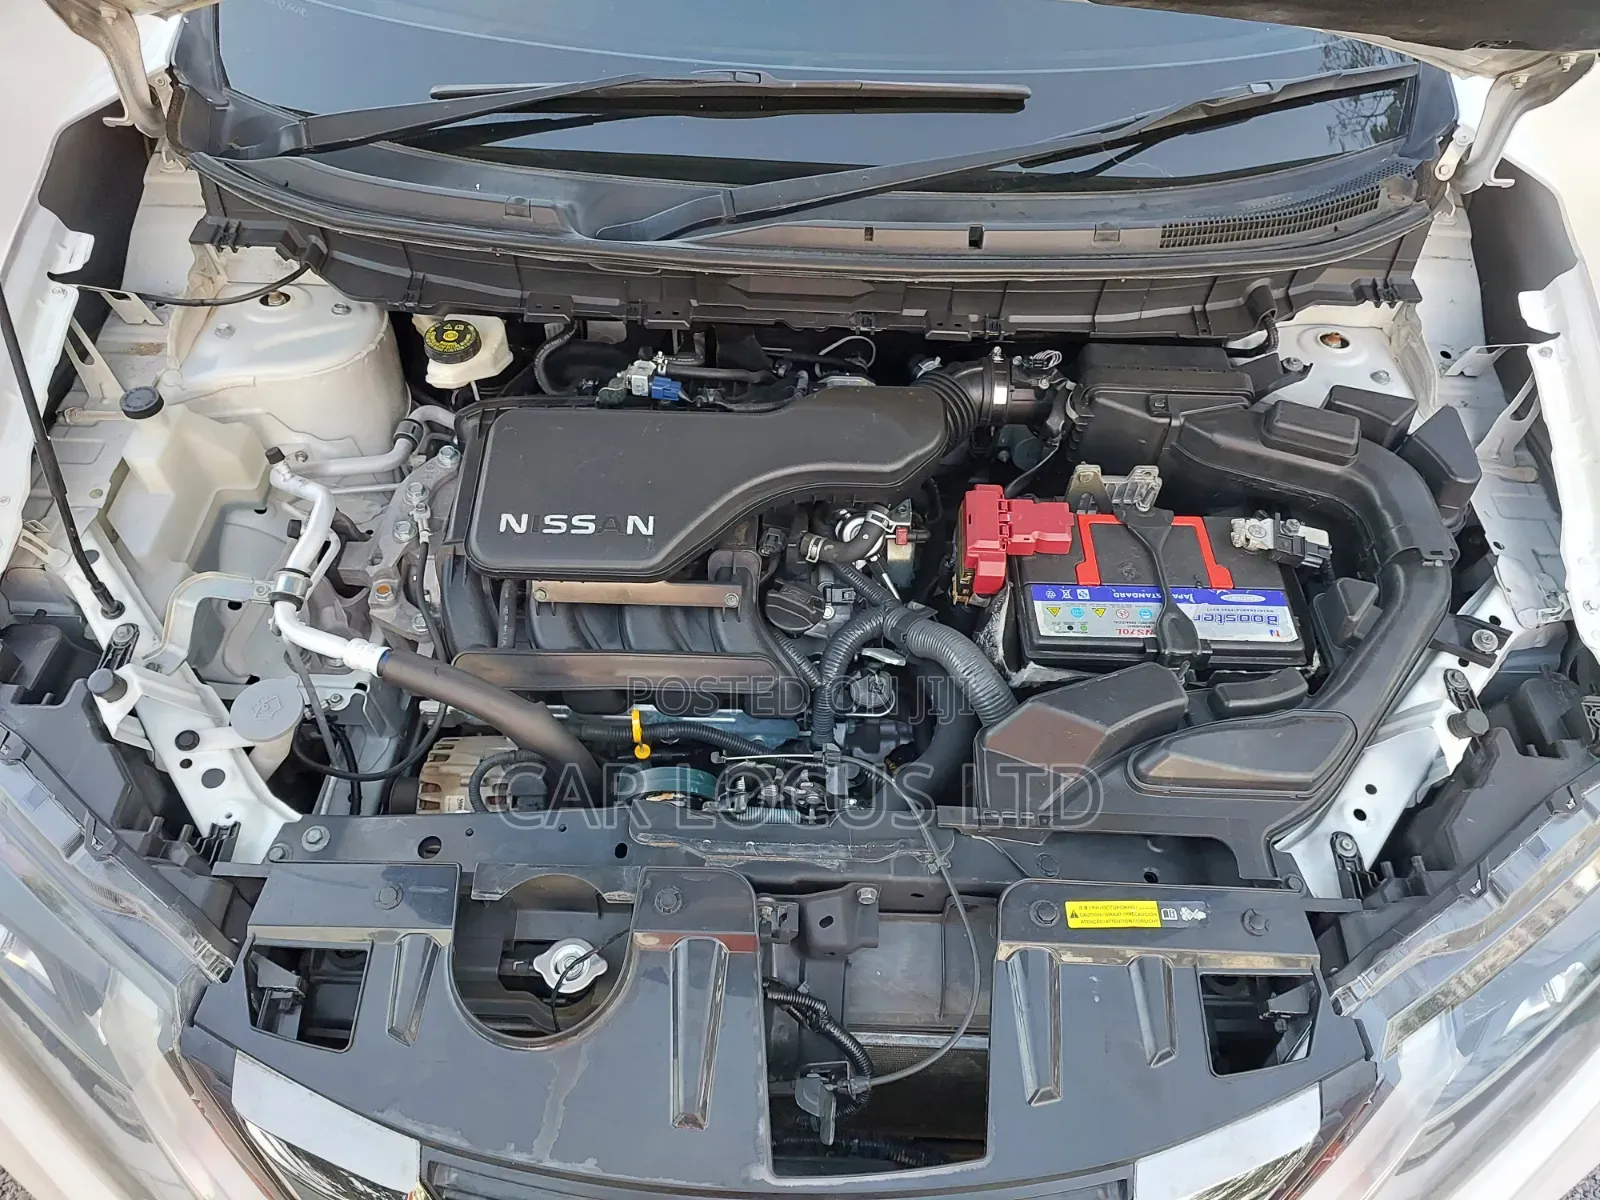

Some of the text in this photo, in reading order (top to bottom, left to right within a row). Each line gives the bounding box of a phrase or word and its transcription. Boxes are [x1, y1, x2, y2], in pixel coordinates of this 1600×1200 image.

[499, 513, 655, 536] NISSAN
[1171, 593, 1196, 603] JAPA
[1194, 613, 1279, 626] Booster
